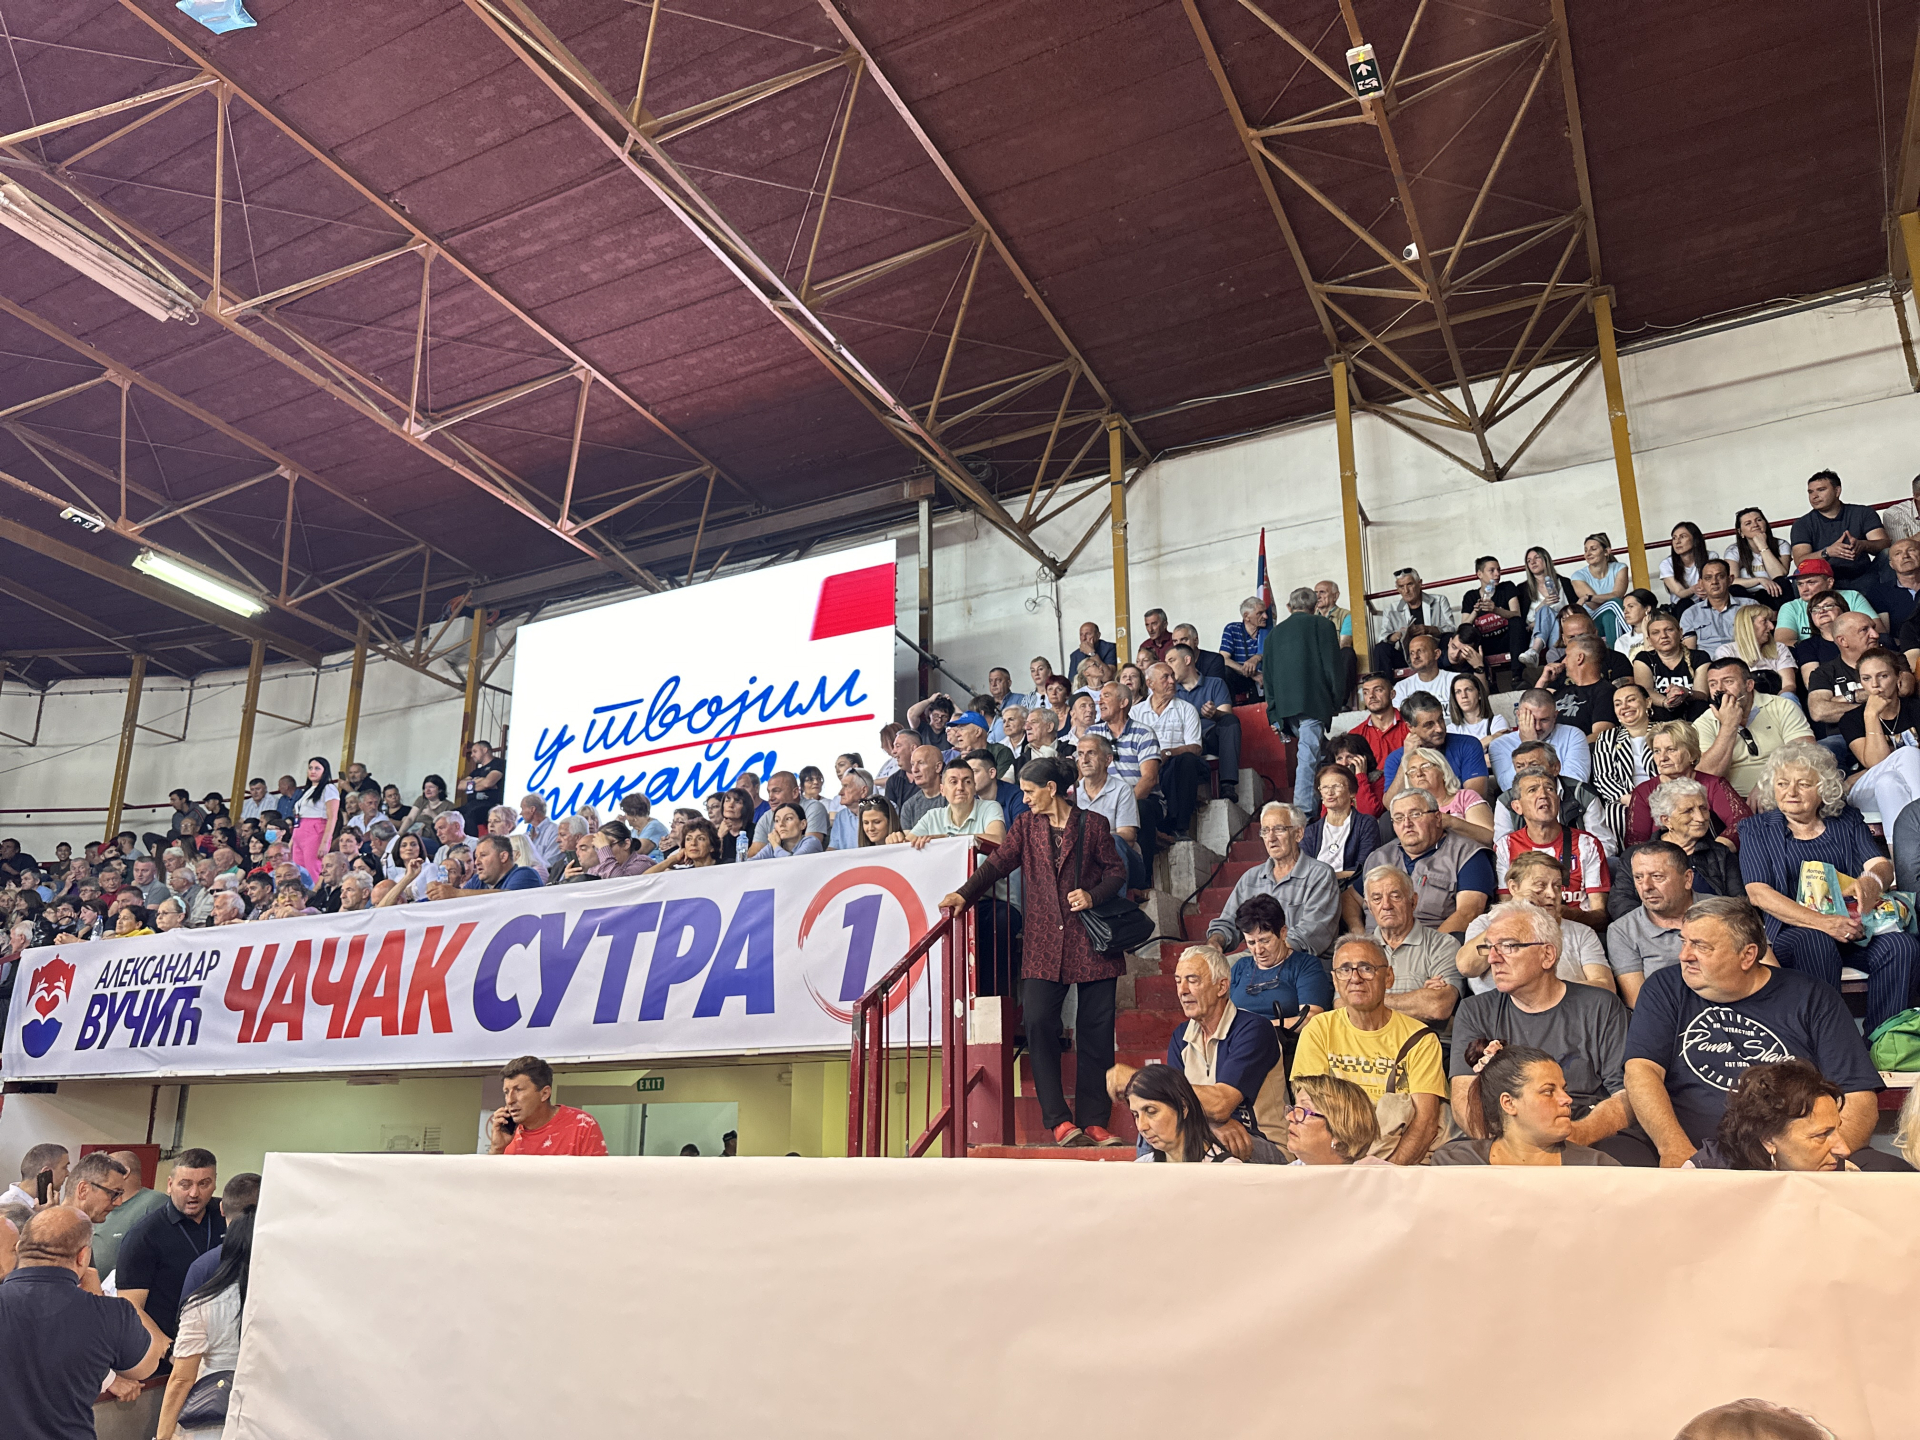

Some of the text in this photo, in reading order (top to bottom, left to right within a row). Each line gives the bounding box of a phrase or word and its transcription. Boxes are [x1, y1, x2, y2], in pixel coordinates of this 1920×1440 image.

[94, 950, 221, 989] АЛЕКСАНДАР
[223, 888, 884, 1044] ЧАЧАК СУТРА 1
[75, 985, 203, 1051] ВУЧИЋ
[1678, 1028, 1735, 1057] Power
[639, 1079, 662, 1090] EXIT
